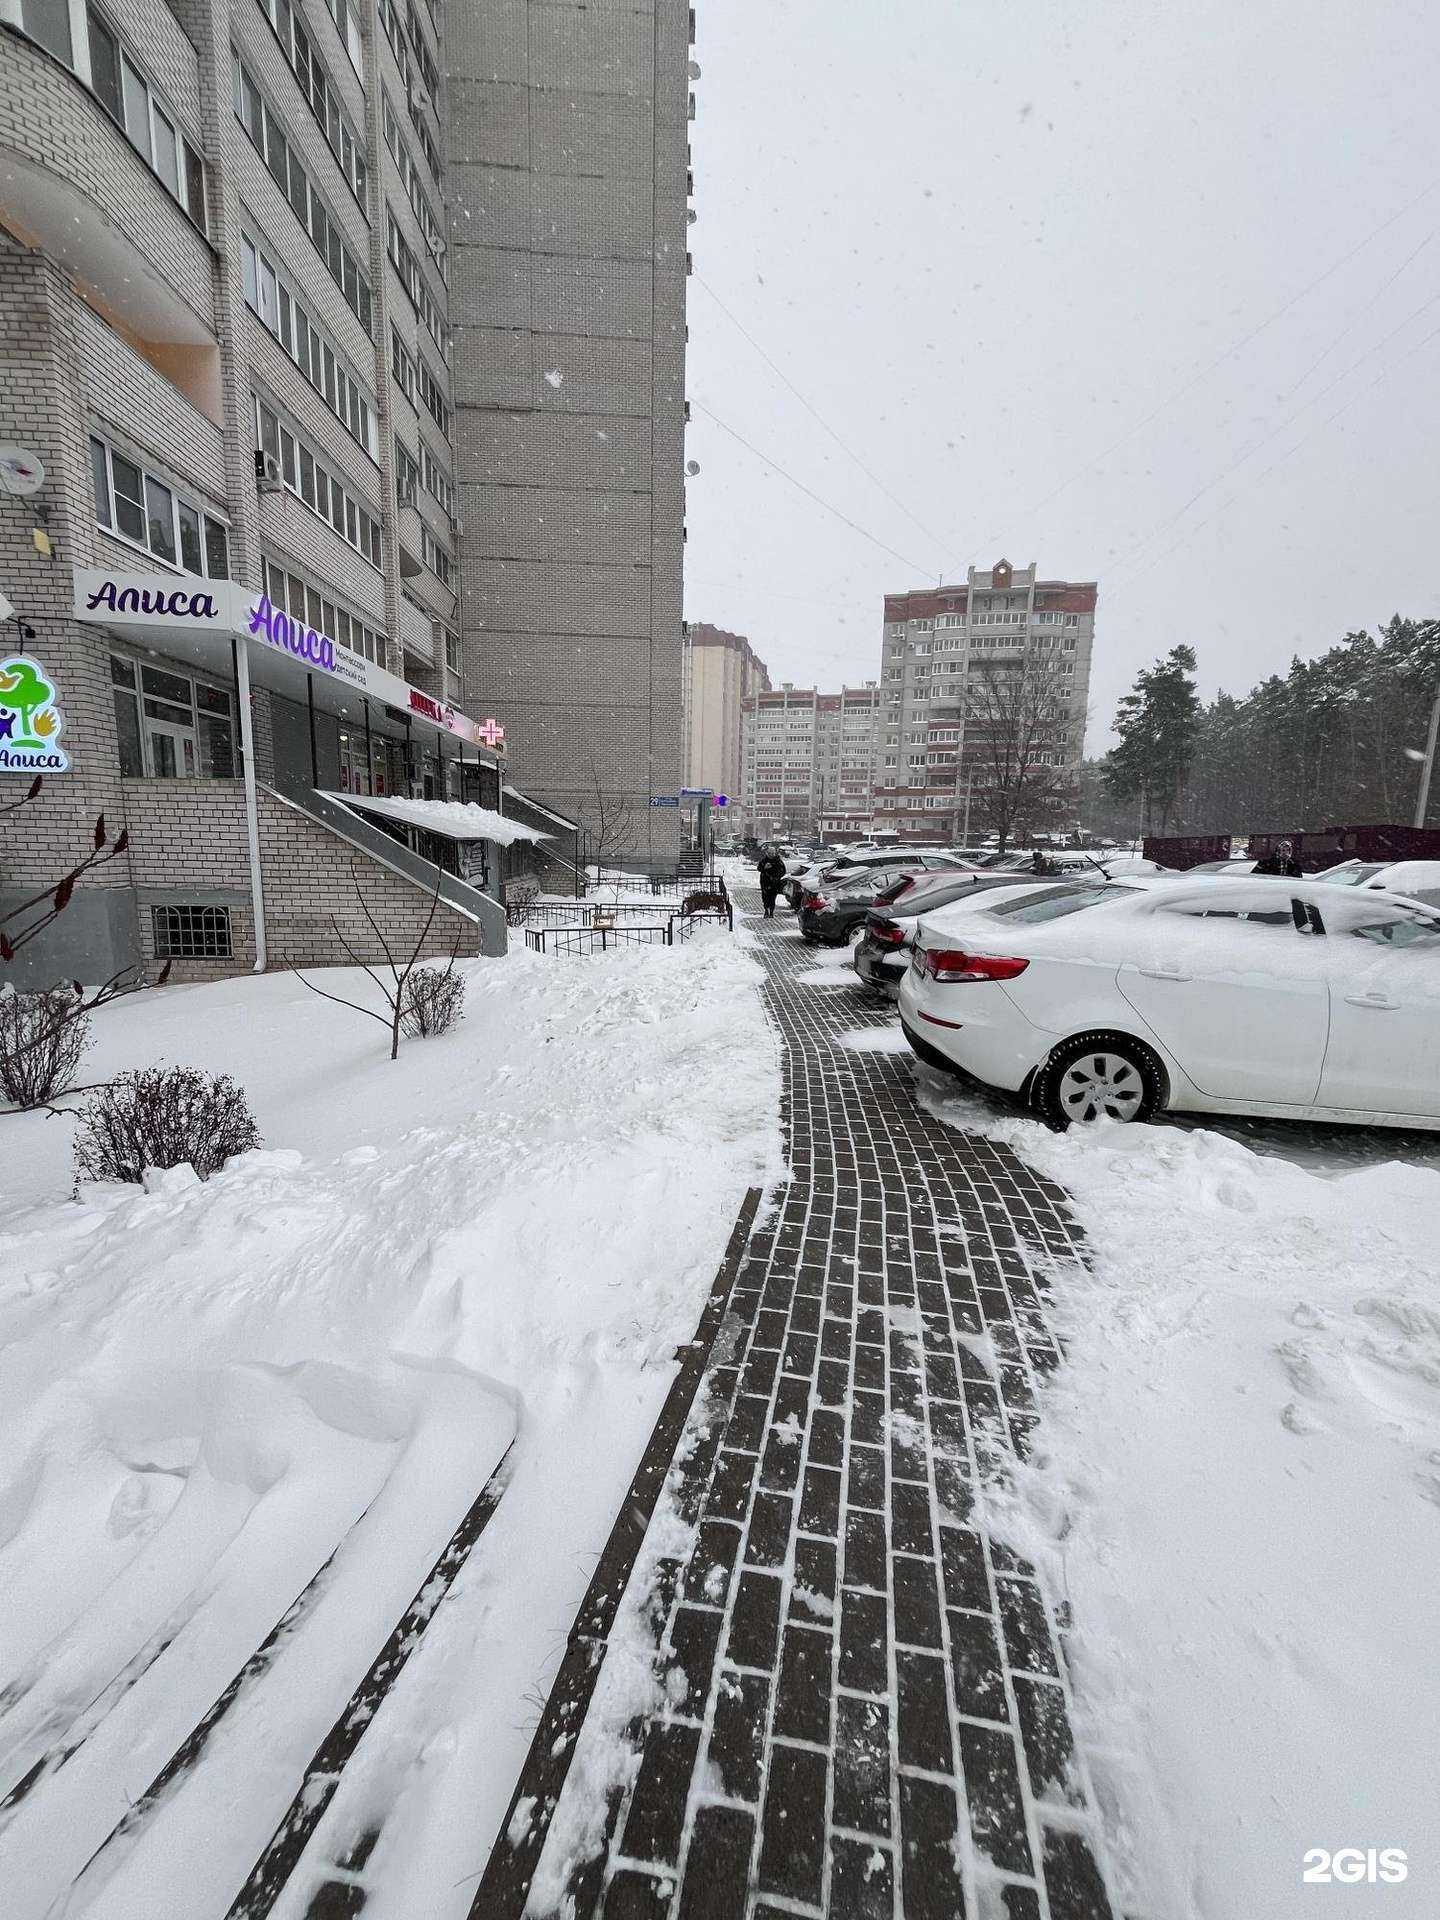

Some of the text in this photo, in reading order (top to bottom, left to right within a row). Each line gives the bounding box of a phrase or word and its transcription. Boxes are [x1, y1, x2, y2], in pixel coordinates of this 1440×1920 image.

[86, 582, 219, 618] Алиса
[249, 592, 337, 672] Алиса
[0, 749, 64, 768] Алиса
